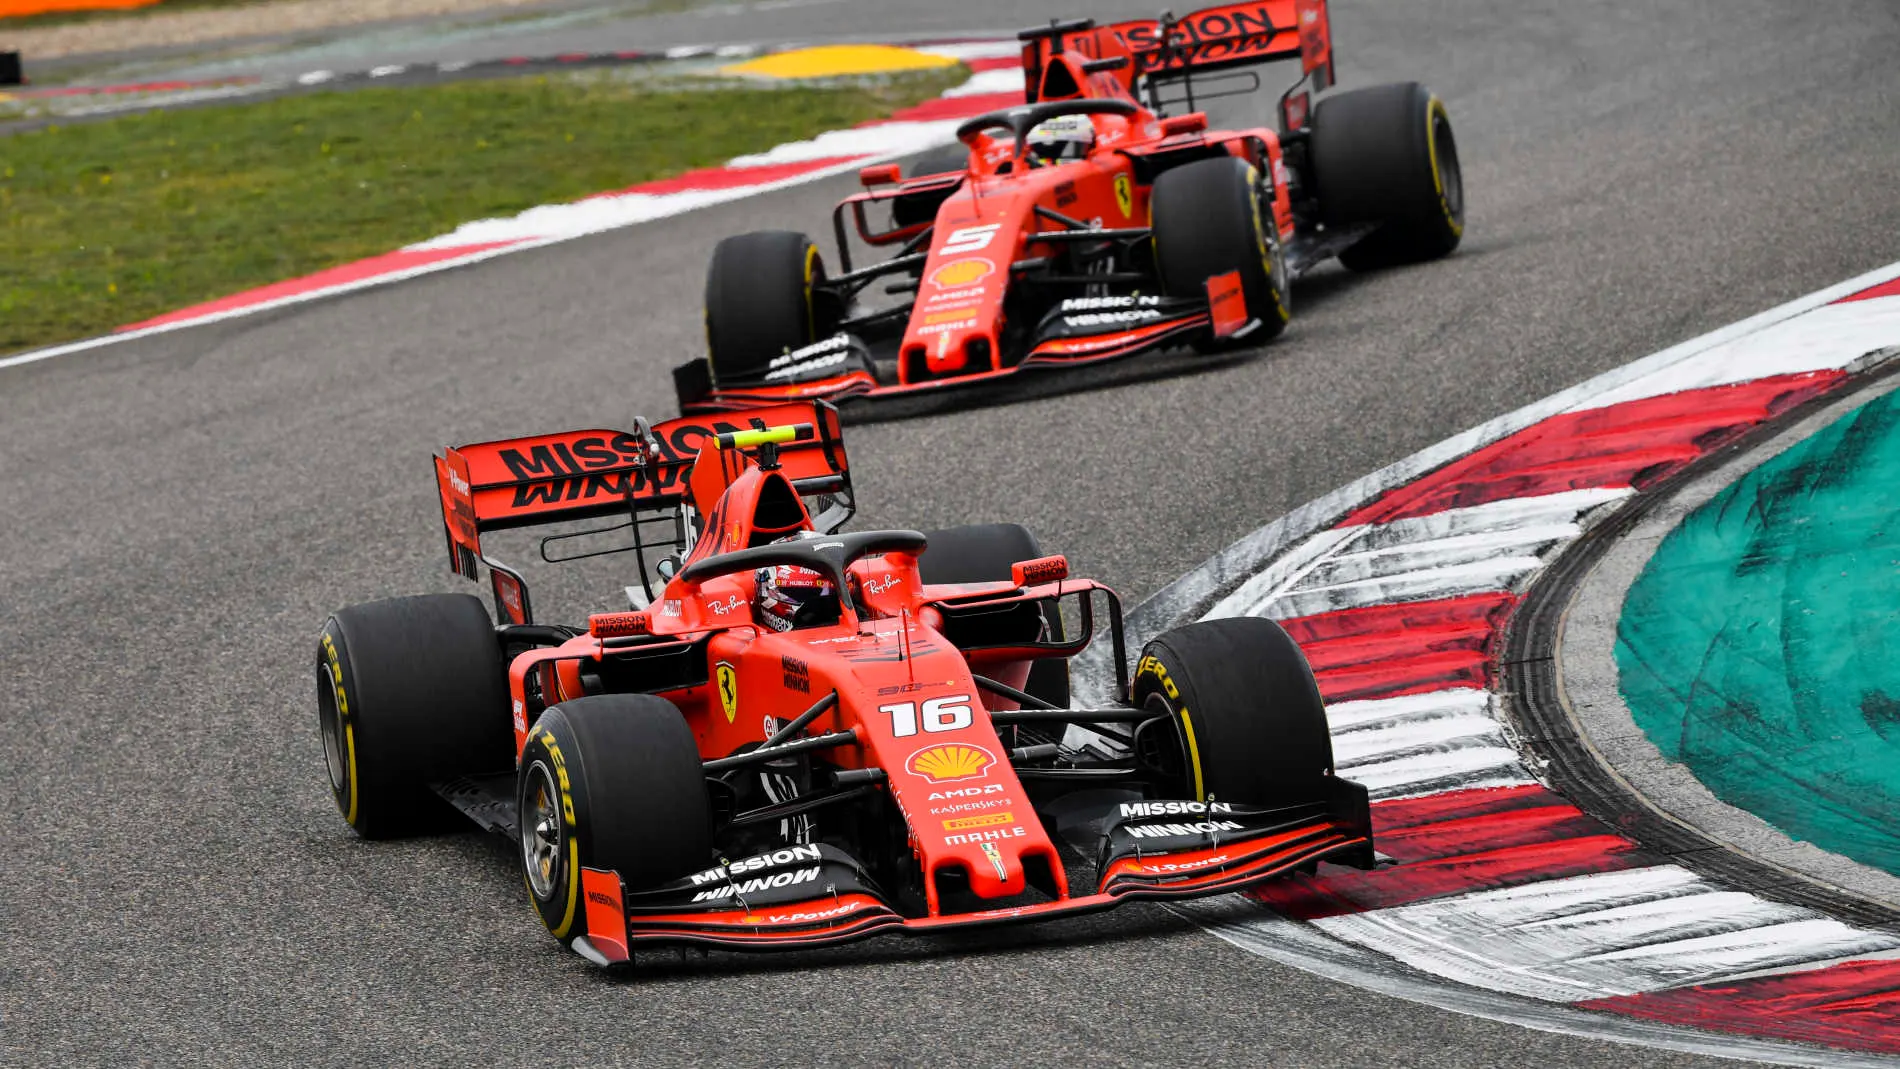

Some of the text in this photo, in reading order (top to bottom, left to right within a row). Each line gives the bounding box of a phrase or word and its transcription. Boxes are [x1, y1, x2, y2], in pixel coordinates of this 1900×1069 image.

[938, 223, 1002, 256] 5
[1023, 560, 1065, 574] MISSION
[864, 574, 901, 594] Ray-Ban
[708, 595, 746, 615] Ray-Ban
[595, 615, 646, 625] MISSION
[782, 655, 809, 678] MISSION
[784, 672, 810, 694] WINNOW
[878, 695, 973, 738] 16
[541, 730, 576, 827] ZERO
[928, 786, 986, 800] AMD
[1120, 802, 1232, 817] MISSION
[944, 827, 1027, 846] MAHLE
[1124, 820, 1245, 838] WINNOW
[690, 844, 822, 885] MISSION
[1144, 855, 1228, 873] V-Power
[691, 866, 821, 902] WINNOW
[769, 901, 861, 922] V-Power
